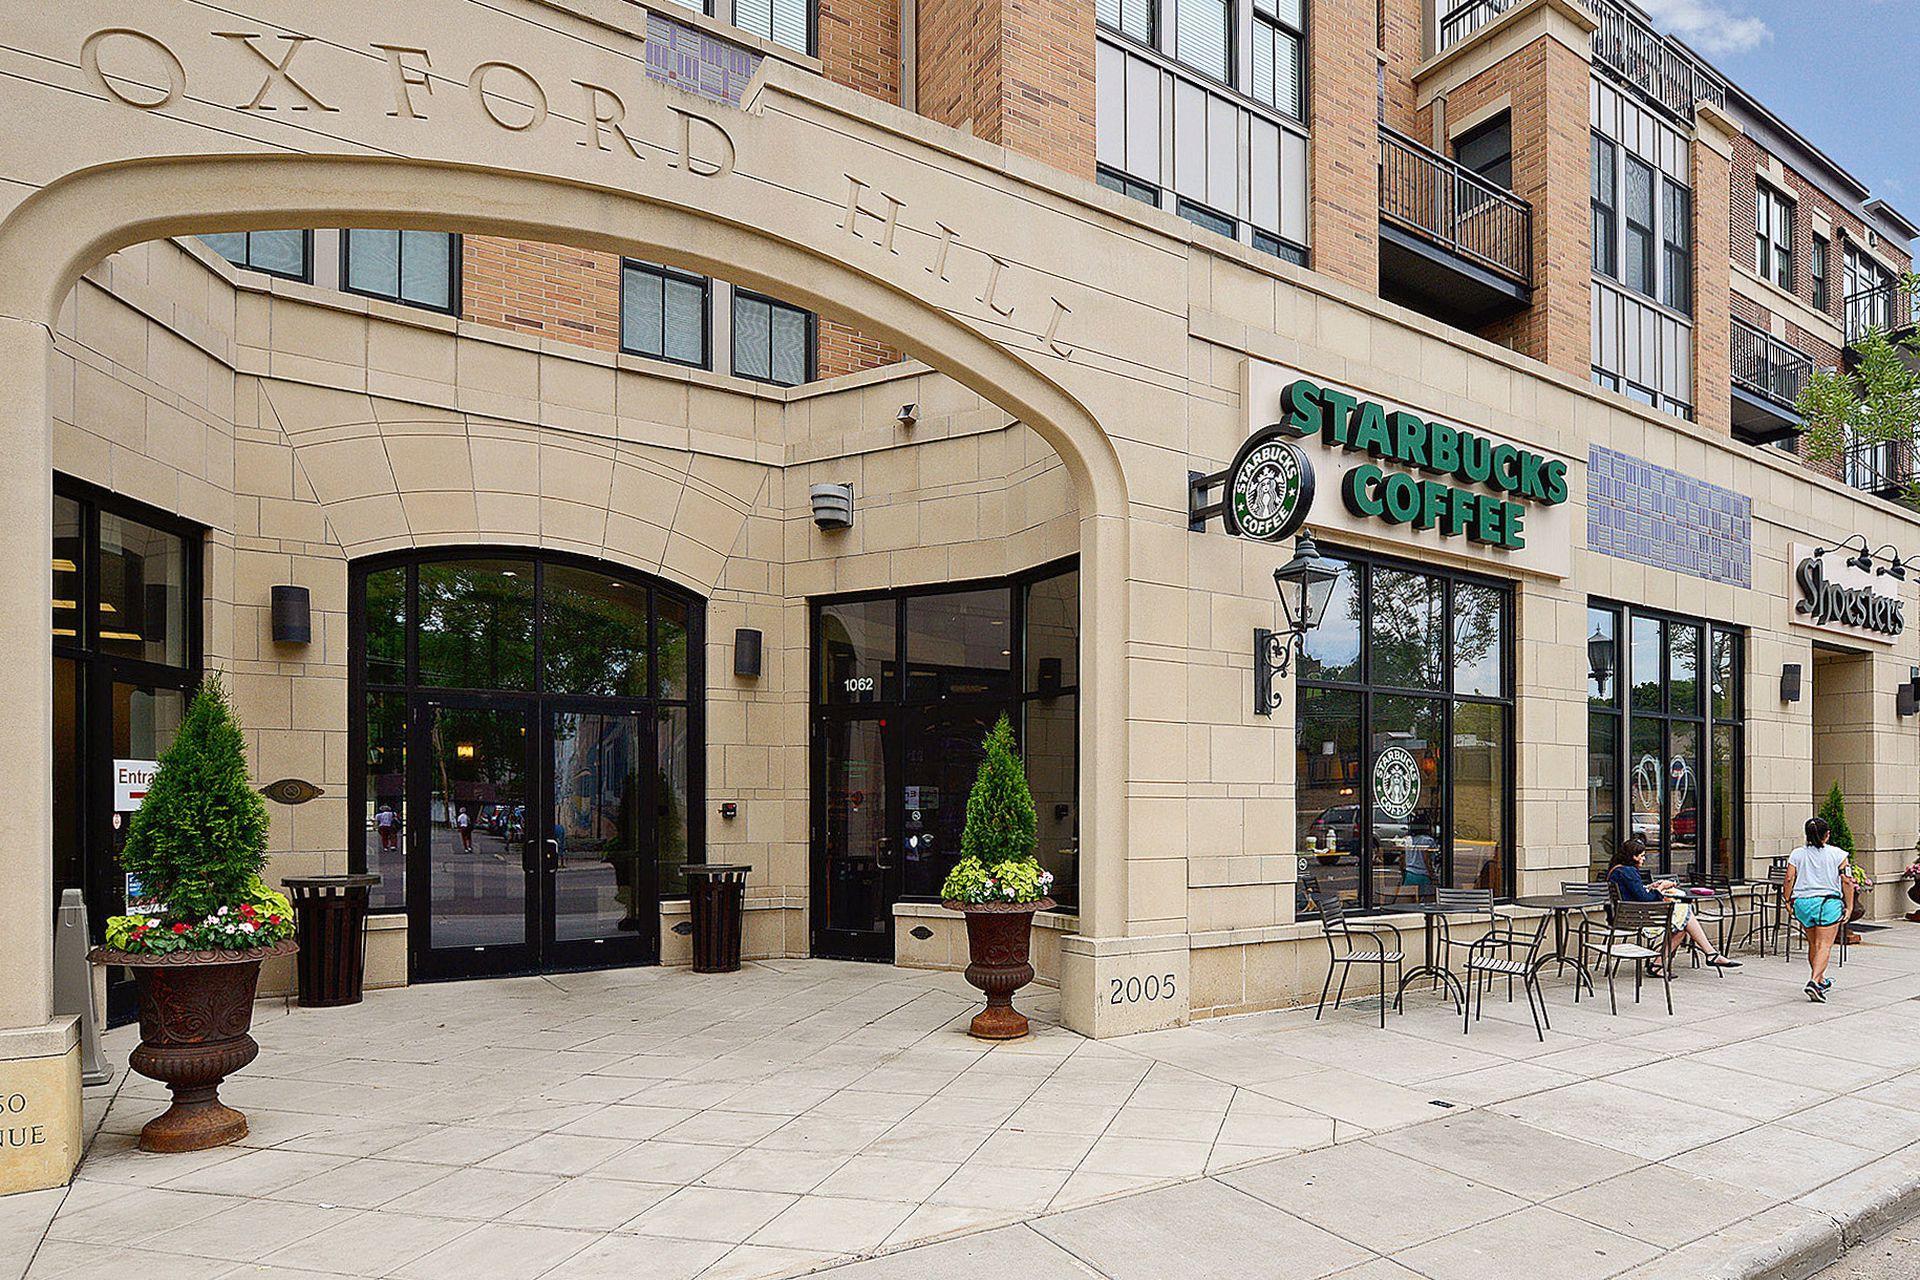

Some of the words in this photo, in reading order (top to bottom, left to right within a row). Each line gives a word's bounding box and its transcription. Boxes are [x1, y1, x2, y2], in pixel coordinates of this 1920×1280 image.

[81, 26, 738, 177] OXFORD
[835, 173, 1074, 361] HILL
[1281, 379, 1567, 504] STARBUCKS
[1236, 446, 1298, 494] STARBUCKS
[1242, 505, 1289, 534] COFFEE
[1342, 463, 1526, 551] COFFEE
[1795, 557, 1905, 635] Shoesters
[843, 677, 874, 692] 1062
[118, 767, 155, 785] Entra
[1376, 750, 1417, 781] STARBUCKS
[1380, 796, 1413, 815] COFFEE
[1110, 973, 1176, 1005] 2005
[0, 1124, 46, 1147] UE
